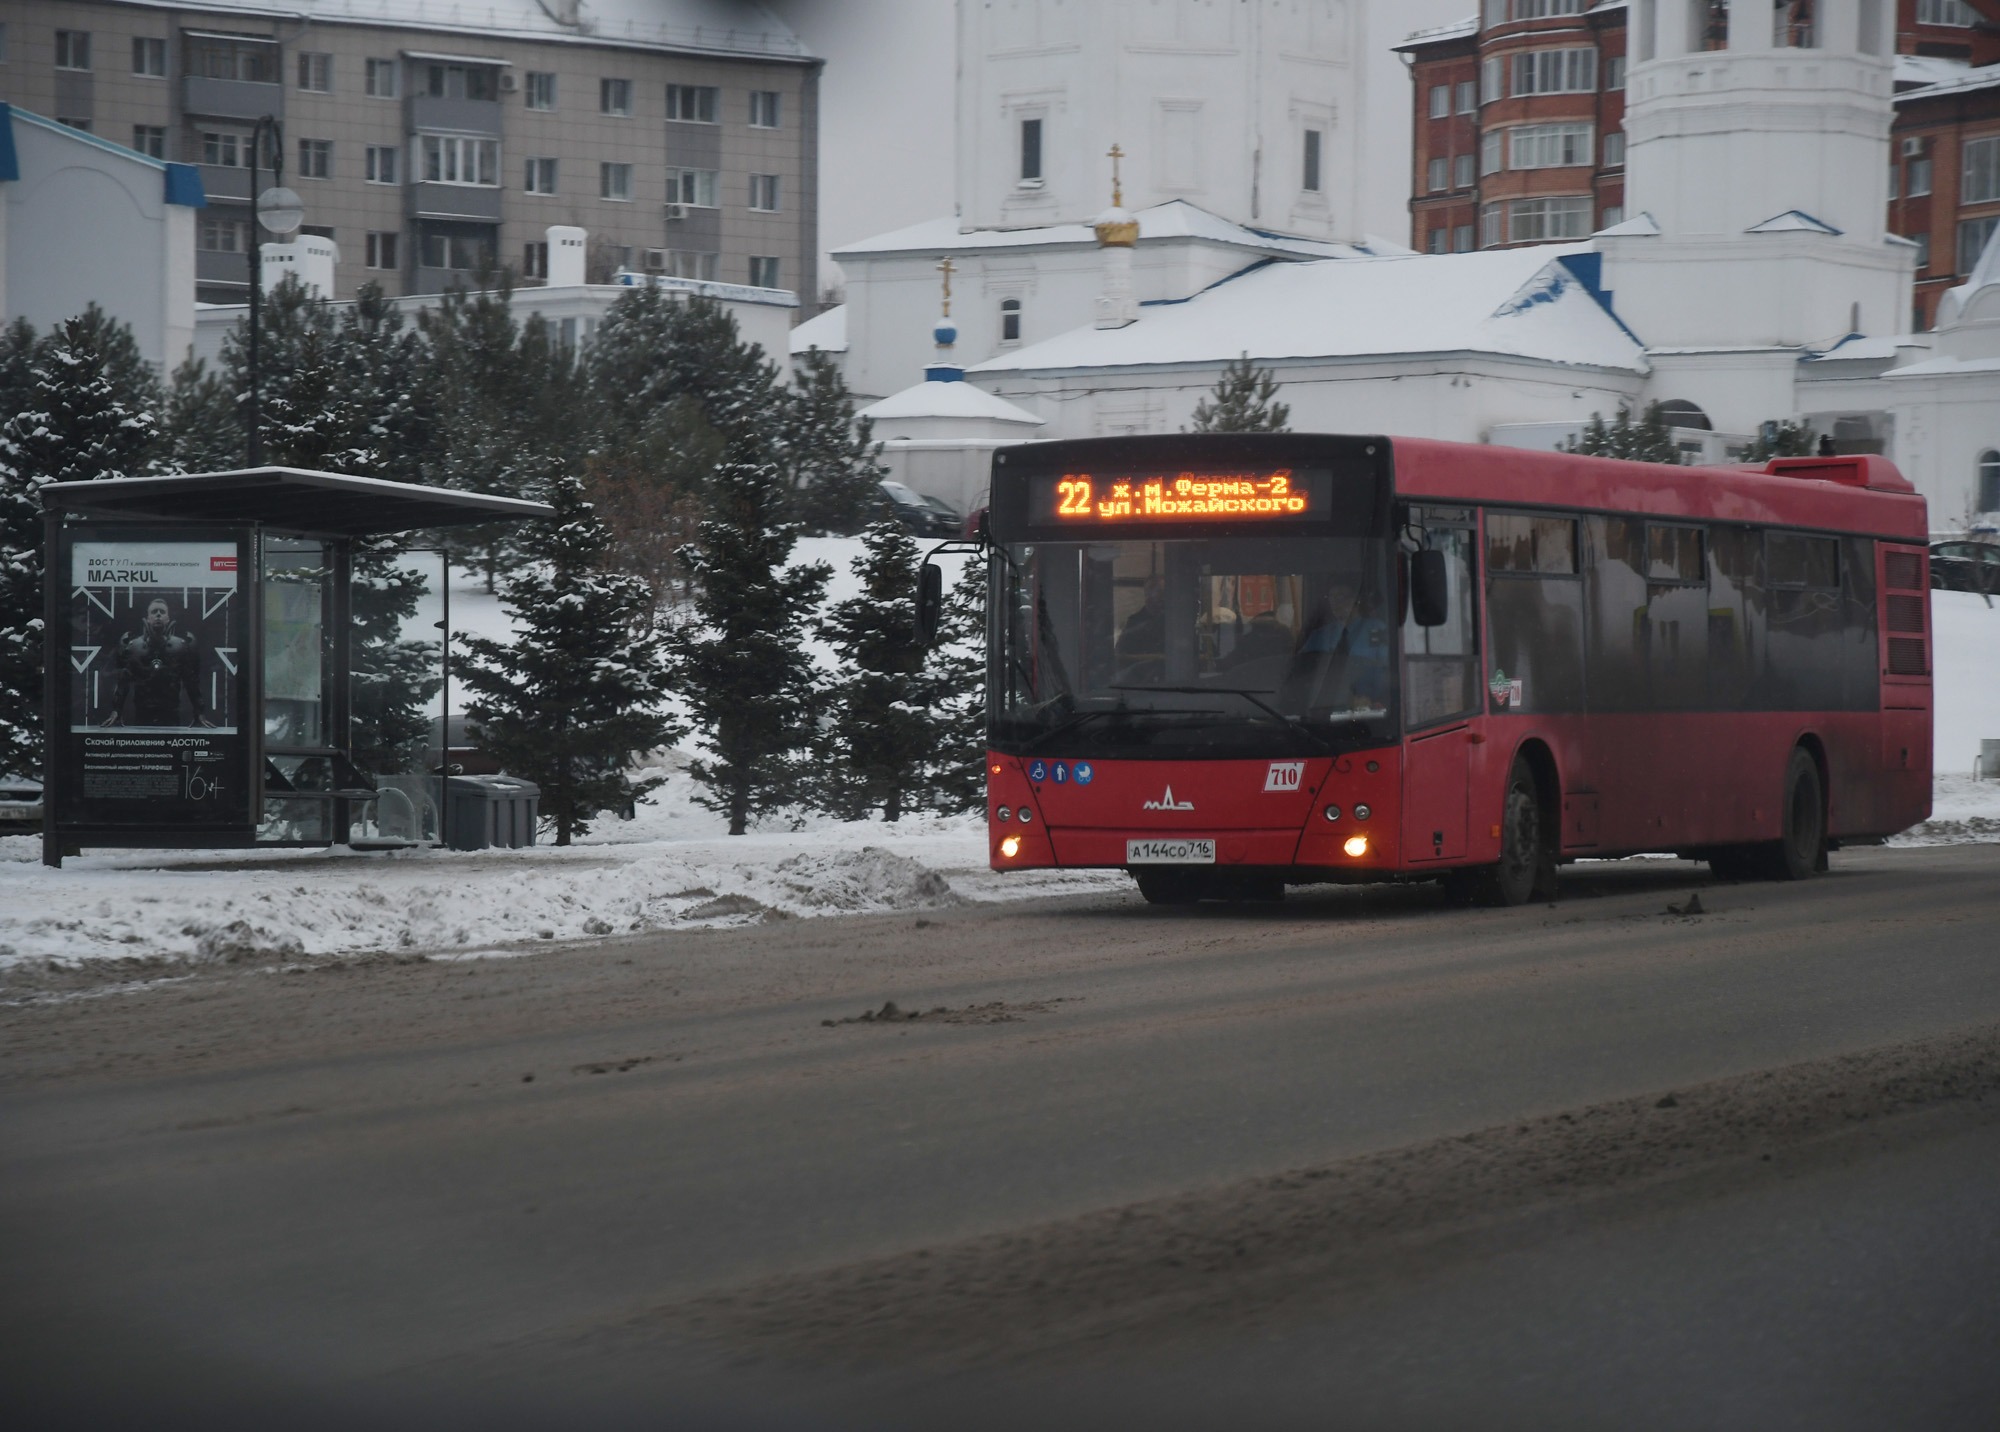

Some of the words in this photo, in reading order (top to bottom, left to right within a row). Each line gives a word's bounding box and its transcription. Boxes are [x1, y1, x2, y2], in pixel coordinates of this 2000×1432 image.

[1058, 481, 1091, 514] 22
[89, 558, 129, 566] ДОСТУП
[88, 570, 158, 582] MARKUL
[85, 738, 114, 746] Скачай
[116, 739, 165, 748] приложение
[167, 739, 210, 747] «ДОСТУП»
[1271, 768, 1298, 786] 710
